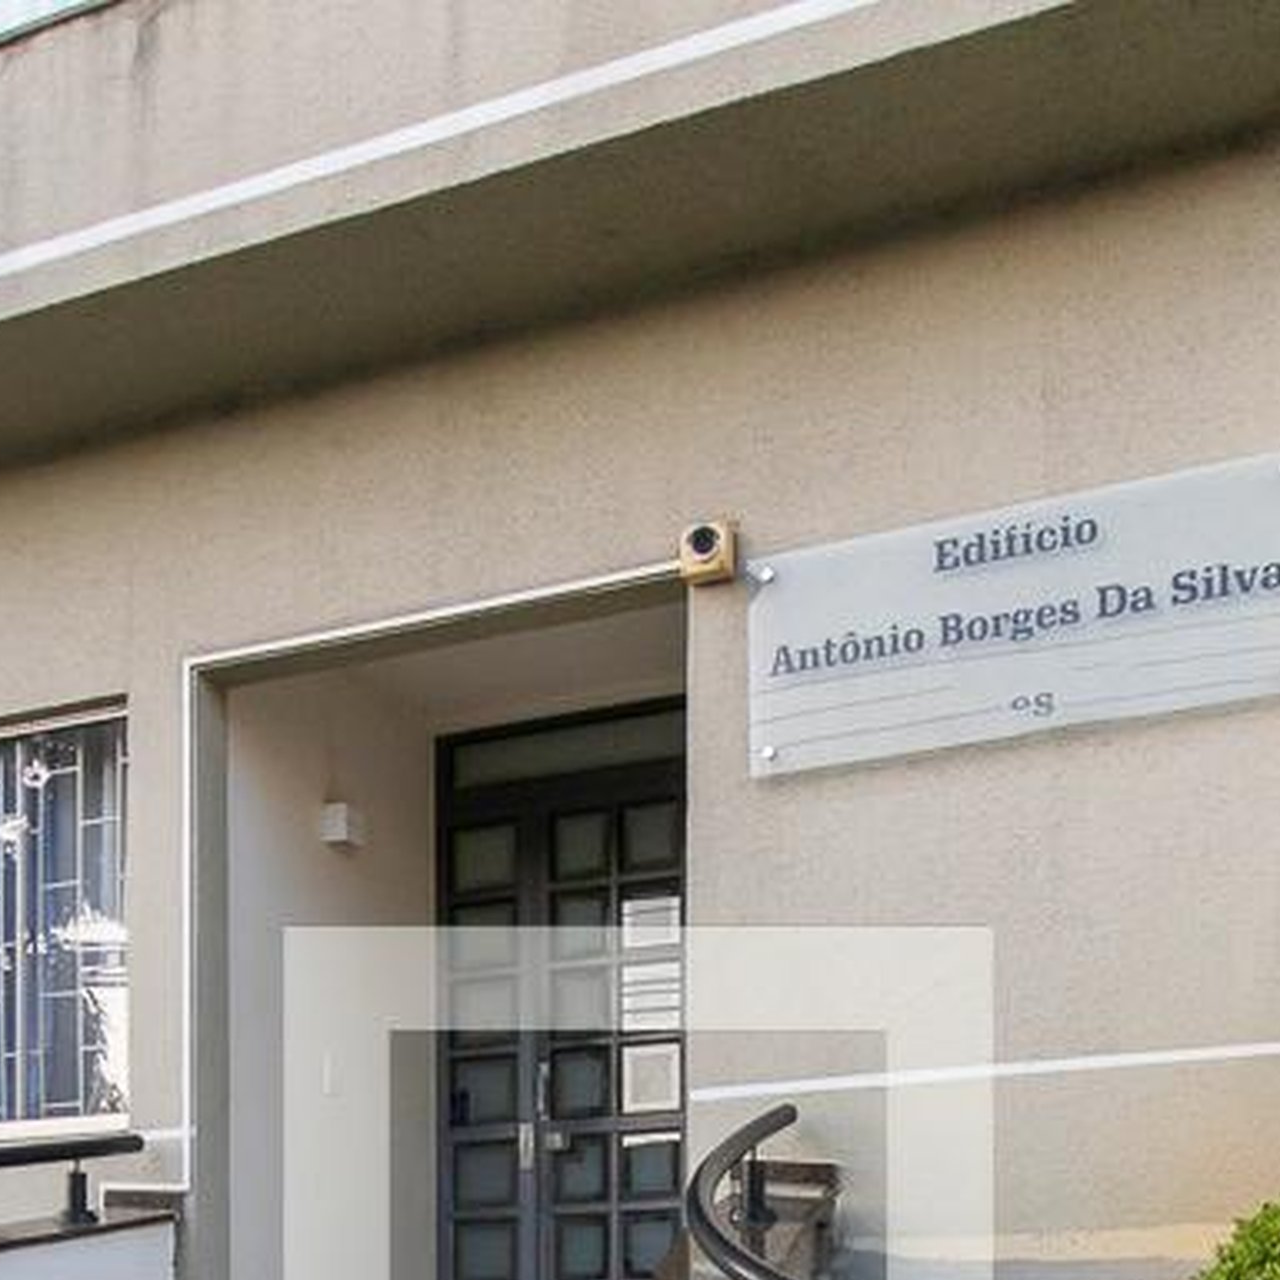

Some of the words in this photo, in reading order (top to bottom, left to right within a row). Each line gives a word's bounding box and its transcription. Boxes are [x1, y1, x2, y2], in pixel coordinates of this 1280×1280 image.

[771, 624, 925, 677] Antônio
[939, 599, 1081, 646] Borges
[1096, 584, 1155, 619] Da
